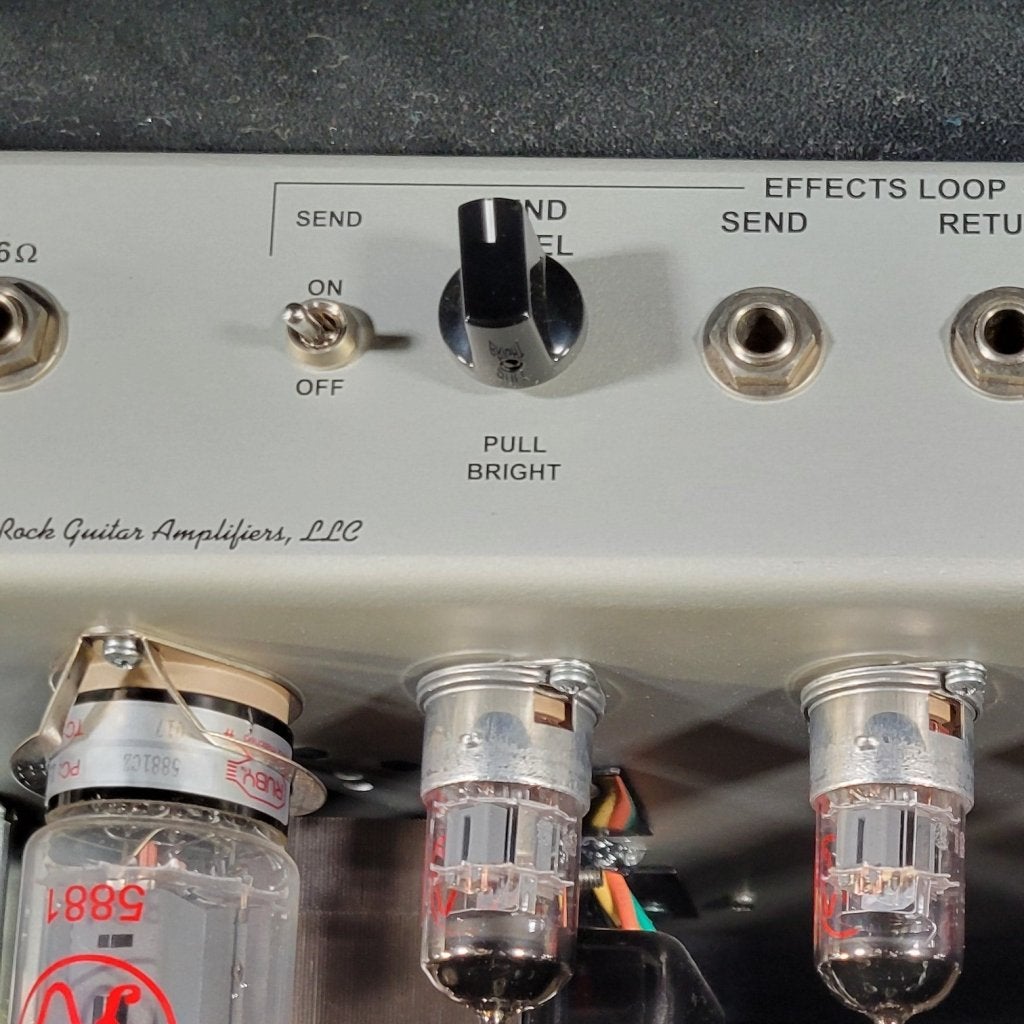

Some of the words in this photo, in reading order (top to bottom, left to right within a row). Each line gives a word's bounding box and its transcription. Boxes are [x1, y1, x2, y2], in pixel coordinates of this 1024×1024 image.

[765, 177, 908, 200] EFFECTS
[919, 178, 1007, 201] LOOP
[295, 210, 363, 228] SEND
[721, 210, 808, 234] SEND
[307, 279, 343, 297] ON
[295, 378, 345, 396] OFF
[483, 435, 547, 454] PULL
[467, 463, 562, 481] BRIGHT
[0, 516, 56, 541] Rock
[62, 517, 145, 548] Guitar
[151, 518, 292, 551] Amplifiers,
[299, 519, 364, 542] LLC
[242, 765, 286, 802] RUBY
[45, 883, 146, 924] 5881
